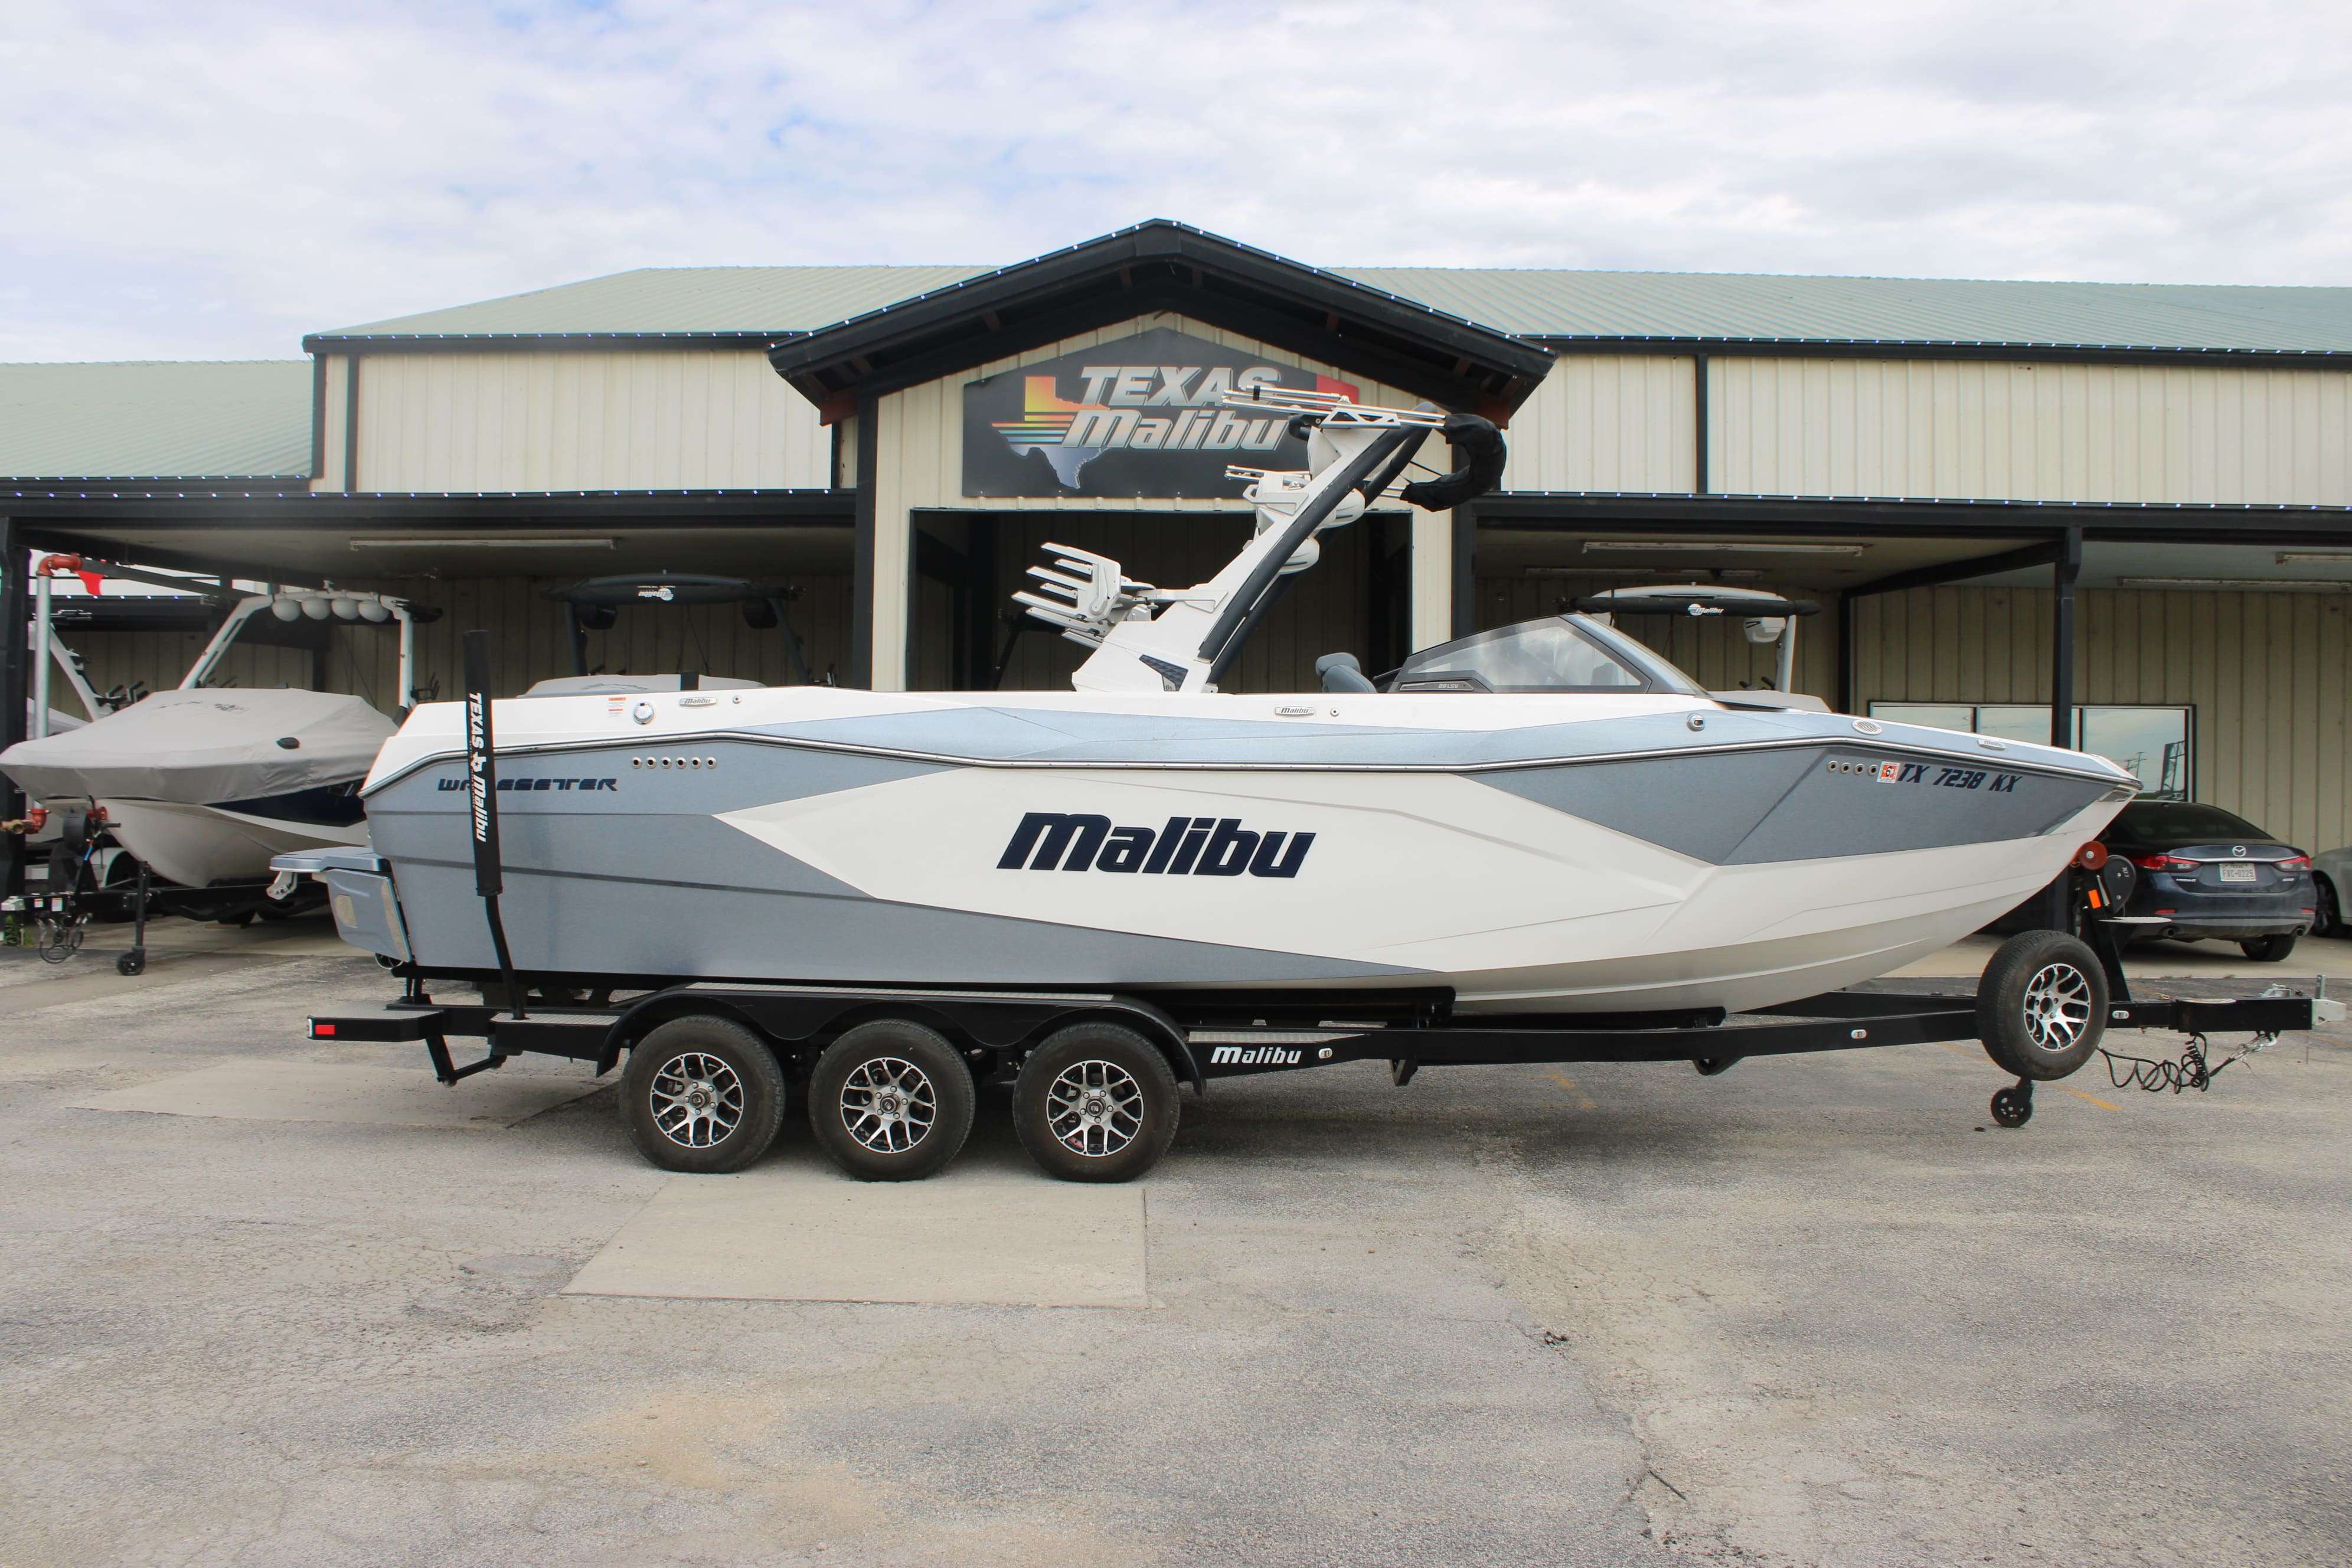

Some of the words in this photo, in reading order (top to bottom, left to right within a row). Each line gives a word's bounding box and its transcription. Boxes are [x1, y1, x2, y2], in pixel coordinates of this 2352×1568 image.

[1080, 366, 1282, 407] TEXAS
[1063, 409, 1291, 450] Malibu
[469, 691, 485, 749] TEXAS
[1897, 763, 1930, 783] TX
[1933, 768, 1987, 789] 7238
[1988, 774, 2022, 793] KX
[473, 774, 488, 842] Malibu
[995, 812, 1317, 878] Malibu
[1210, 1046, 1302, 1064] Malibu
